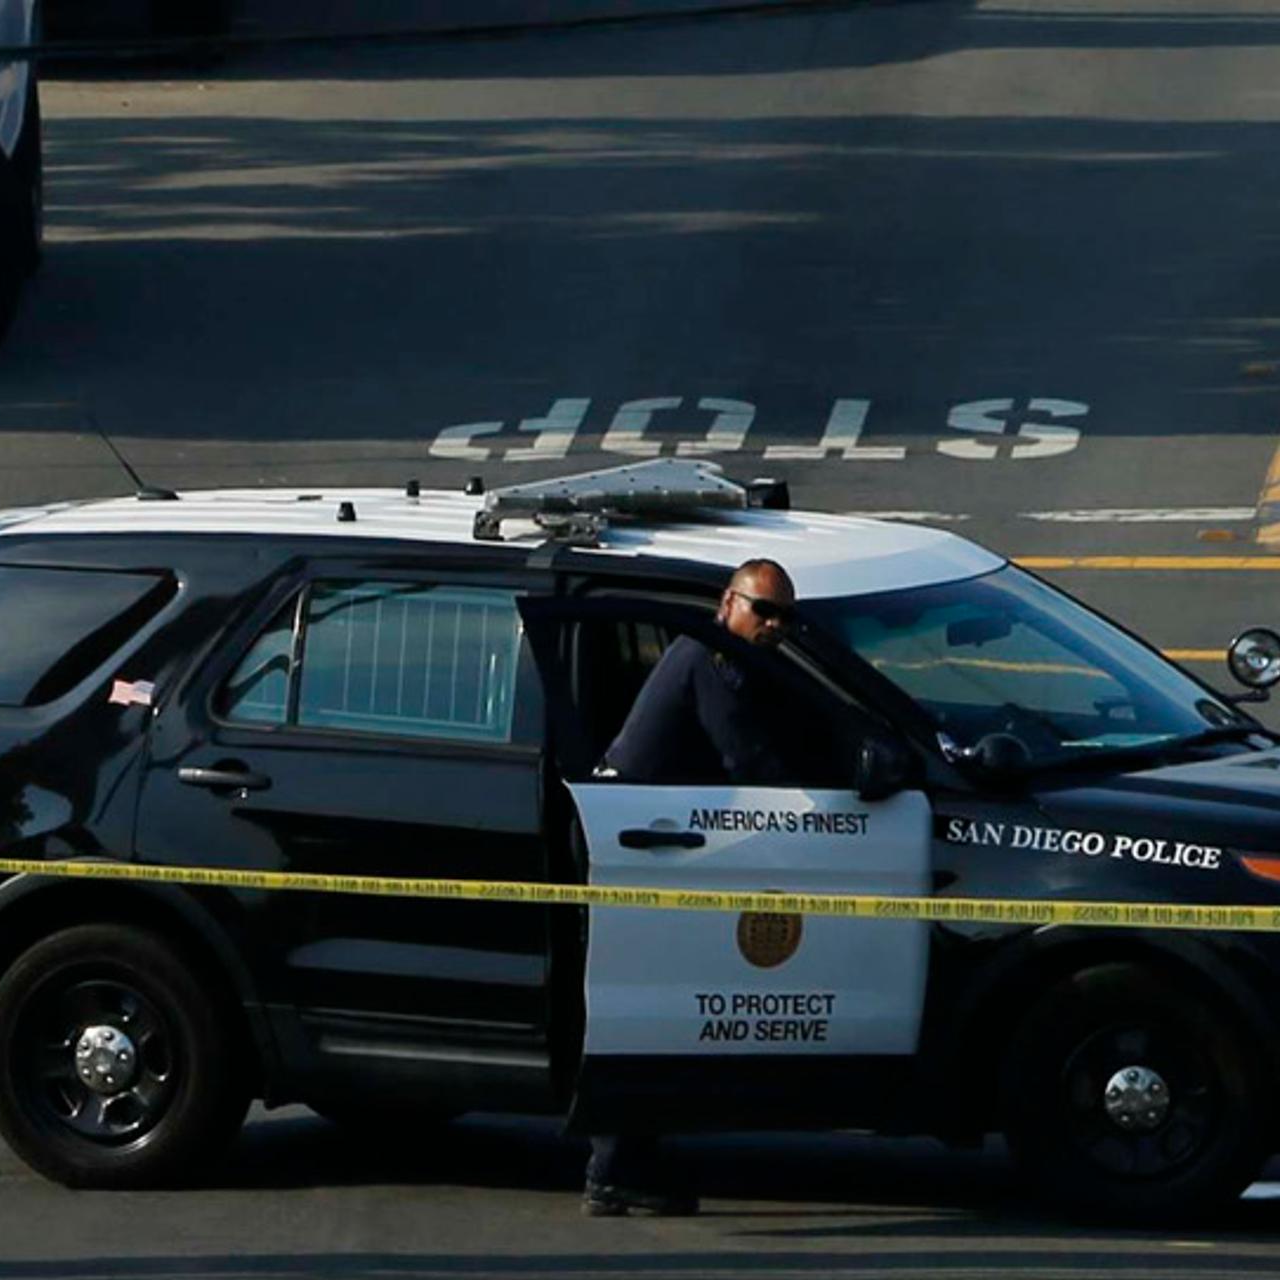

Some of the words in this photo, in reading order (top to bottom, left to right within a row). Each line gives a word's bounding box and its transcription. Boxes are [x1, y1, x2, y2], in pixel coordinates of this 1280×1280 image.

[428, 397, 1089, 462] STOP
[688, 809, 798, 834] AMERICA'S
[803, 811, 869, 836] FINEST
[947, 819, 1002, 846] SAN
[1011, 825, 1104, 856] DIEGO
[1110, 835, 1222, 870] POLICE
[695, 994, 726, 1016] TO
[731, 994, 836, 1017] PROTECT
[699, 1019, 748, 1041] AND
[754, 1020, 828, 1042] SERVE
